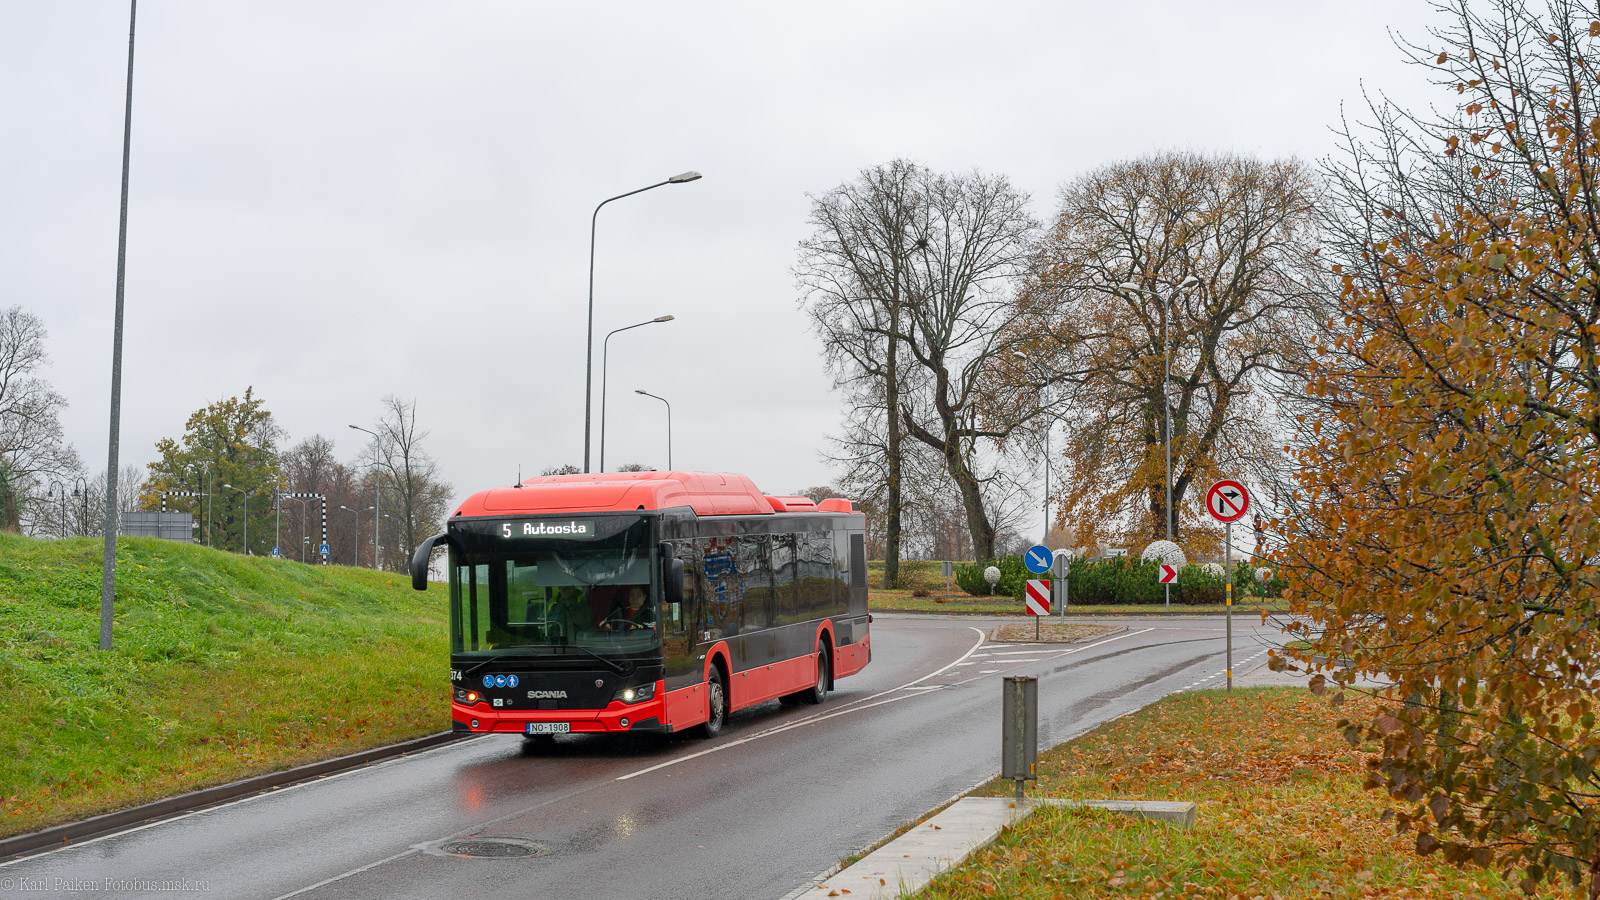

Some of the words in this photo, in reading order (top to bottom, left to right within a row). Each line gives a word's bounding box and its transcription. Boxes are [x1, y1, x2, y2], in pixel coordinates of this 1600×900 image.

[503, 523, 512, 538] 5
[523, 521, 587, 535] Autoosta
[527, 690, 568, 699] SCANIA
[531, 723, 569, 732] NO-1908
